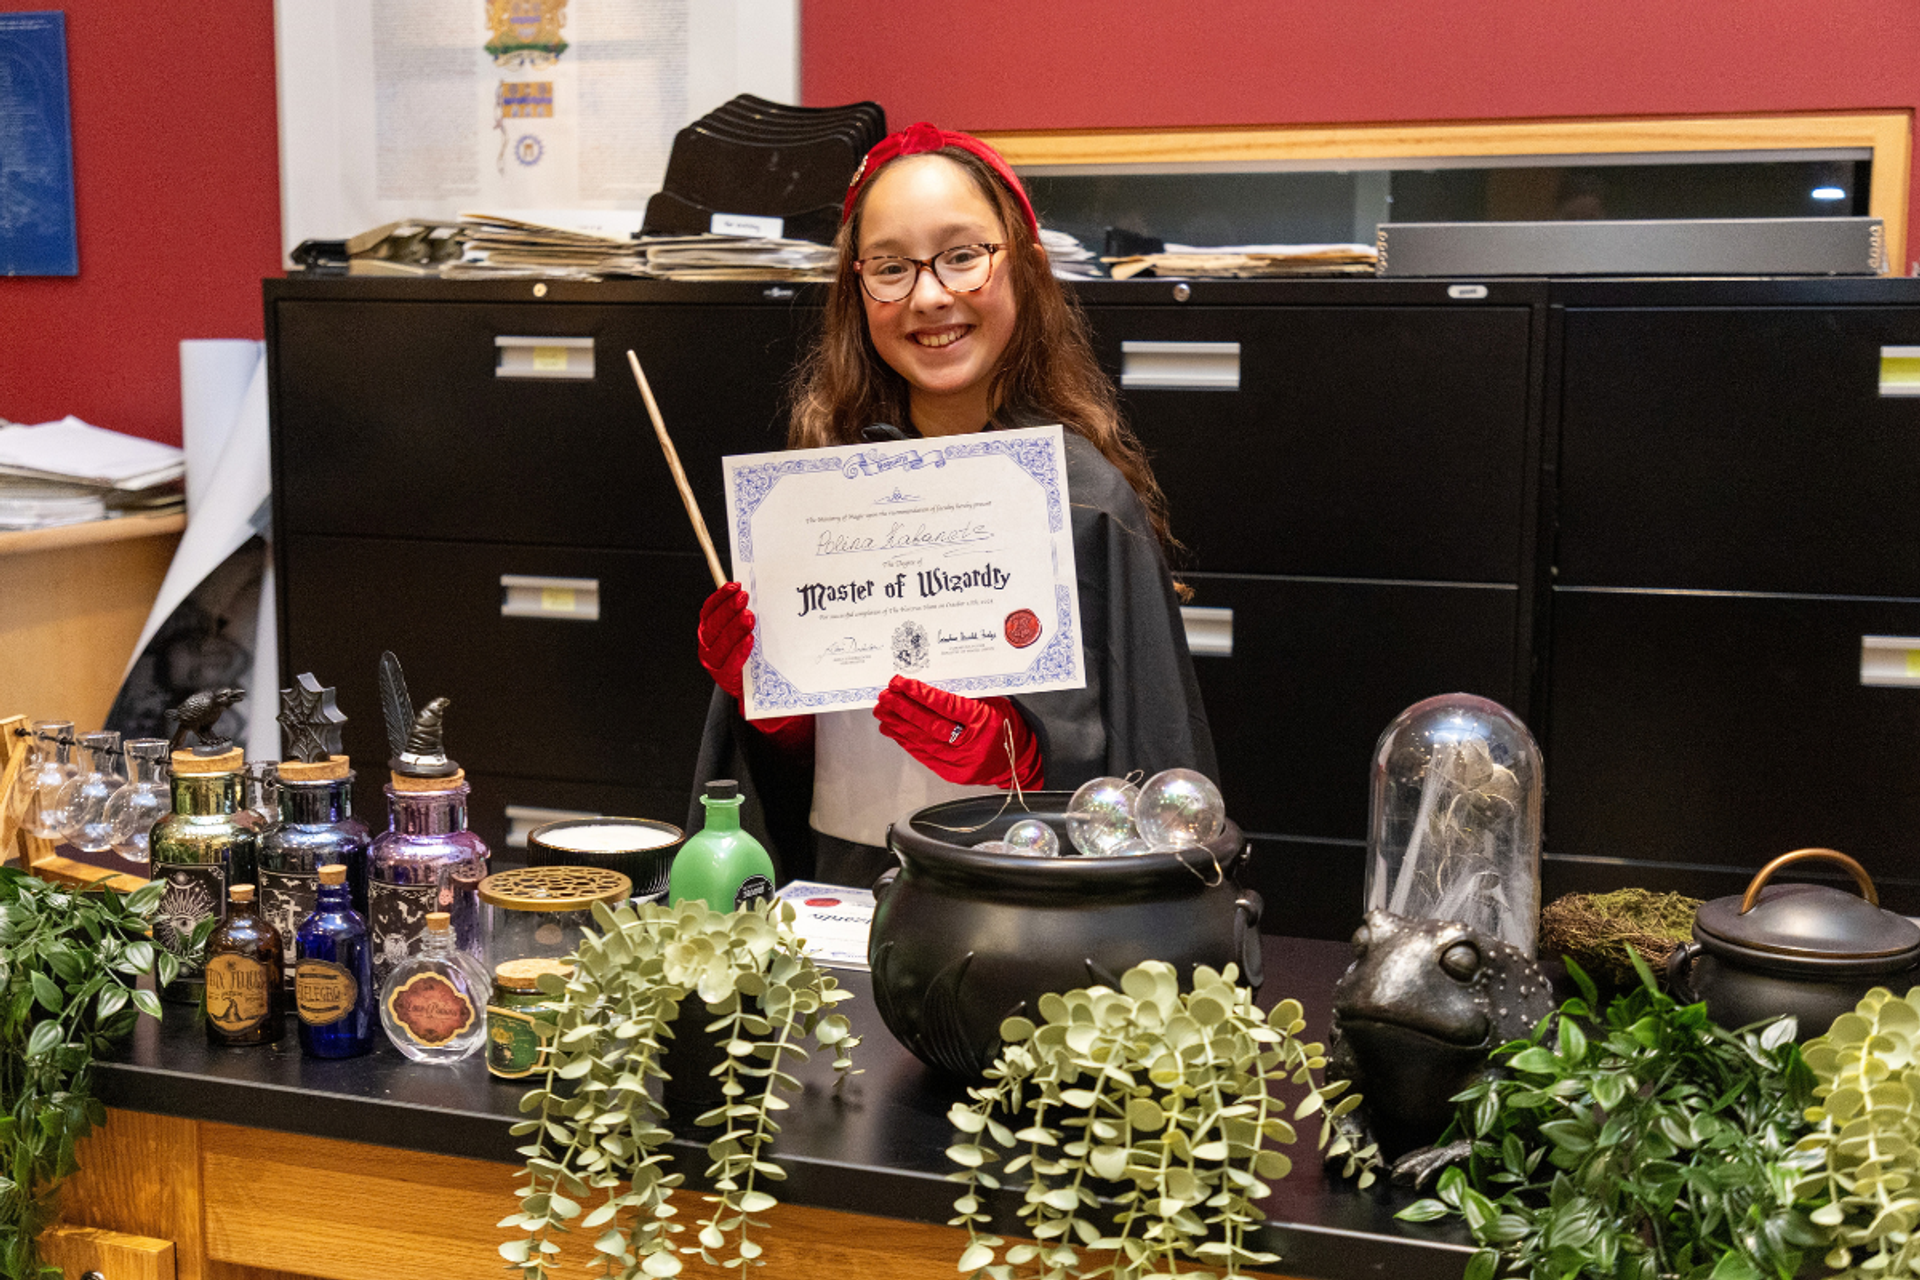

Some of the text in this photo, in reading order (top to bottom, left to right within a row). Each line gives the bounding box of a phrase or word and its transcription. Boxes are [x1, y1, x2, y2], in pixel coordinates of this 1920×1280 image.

[797, 562, 1011, 617] Master of Wizardry
